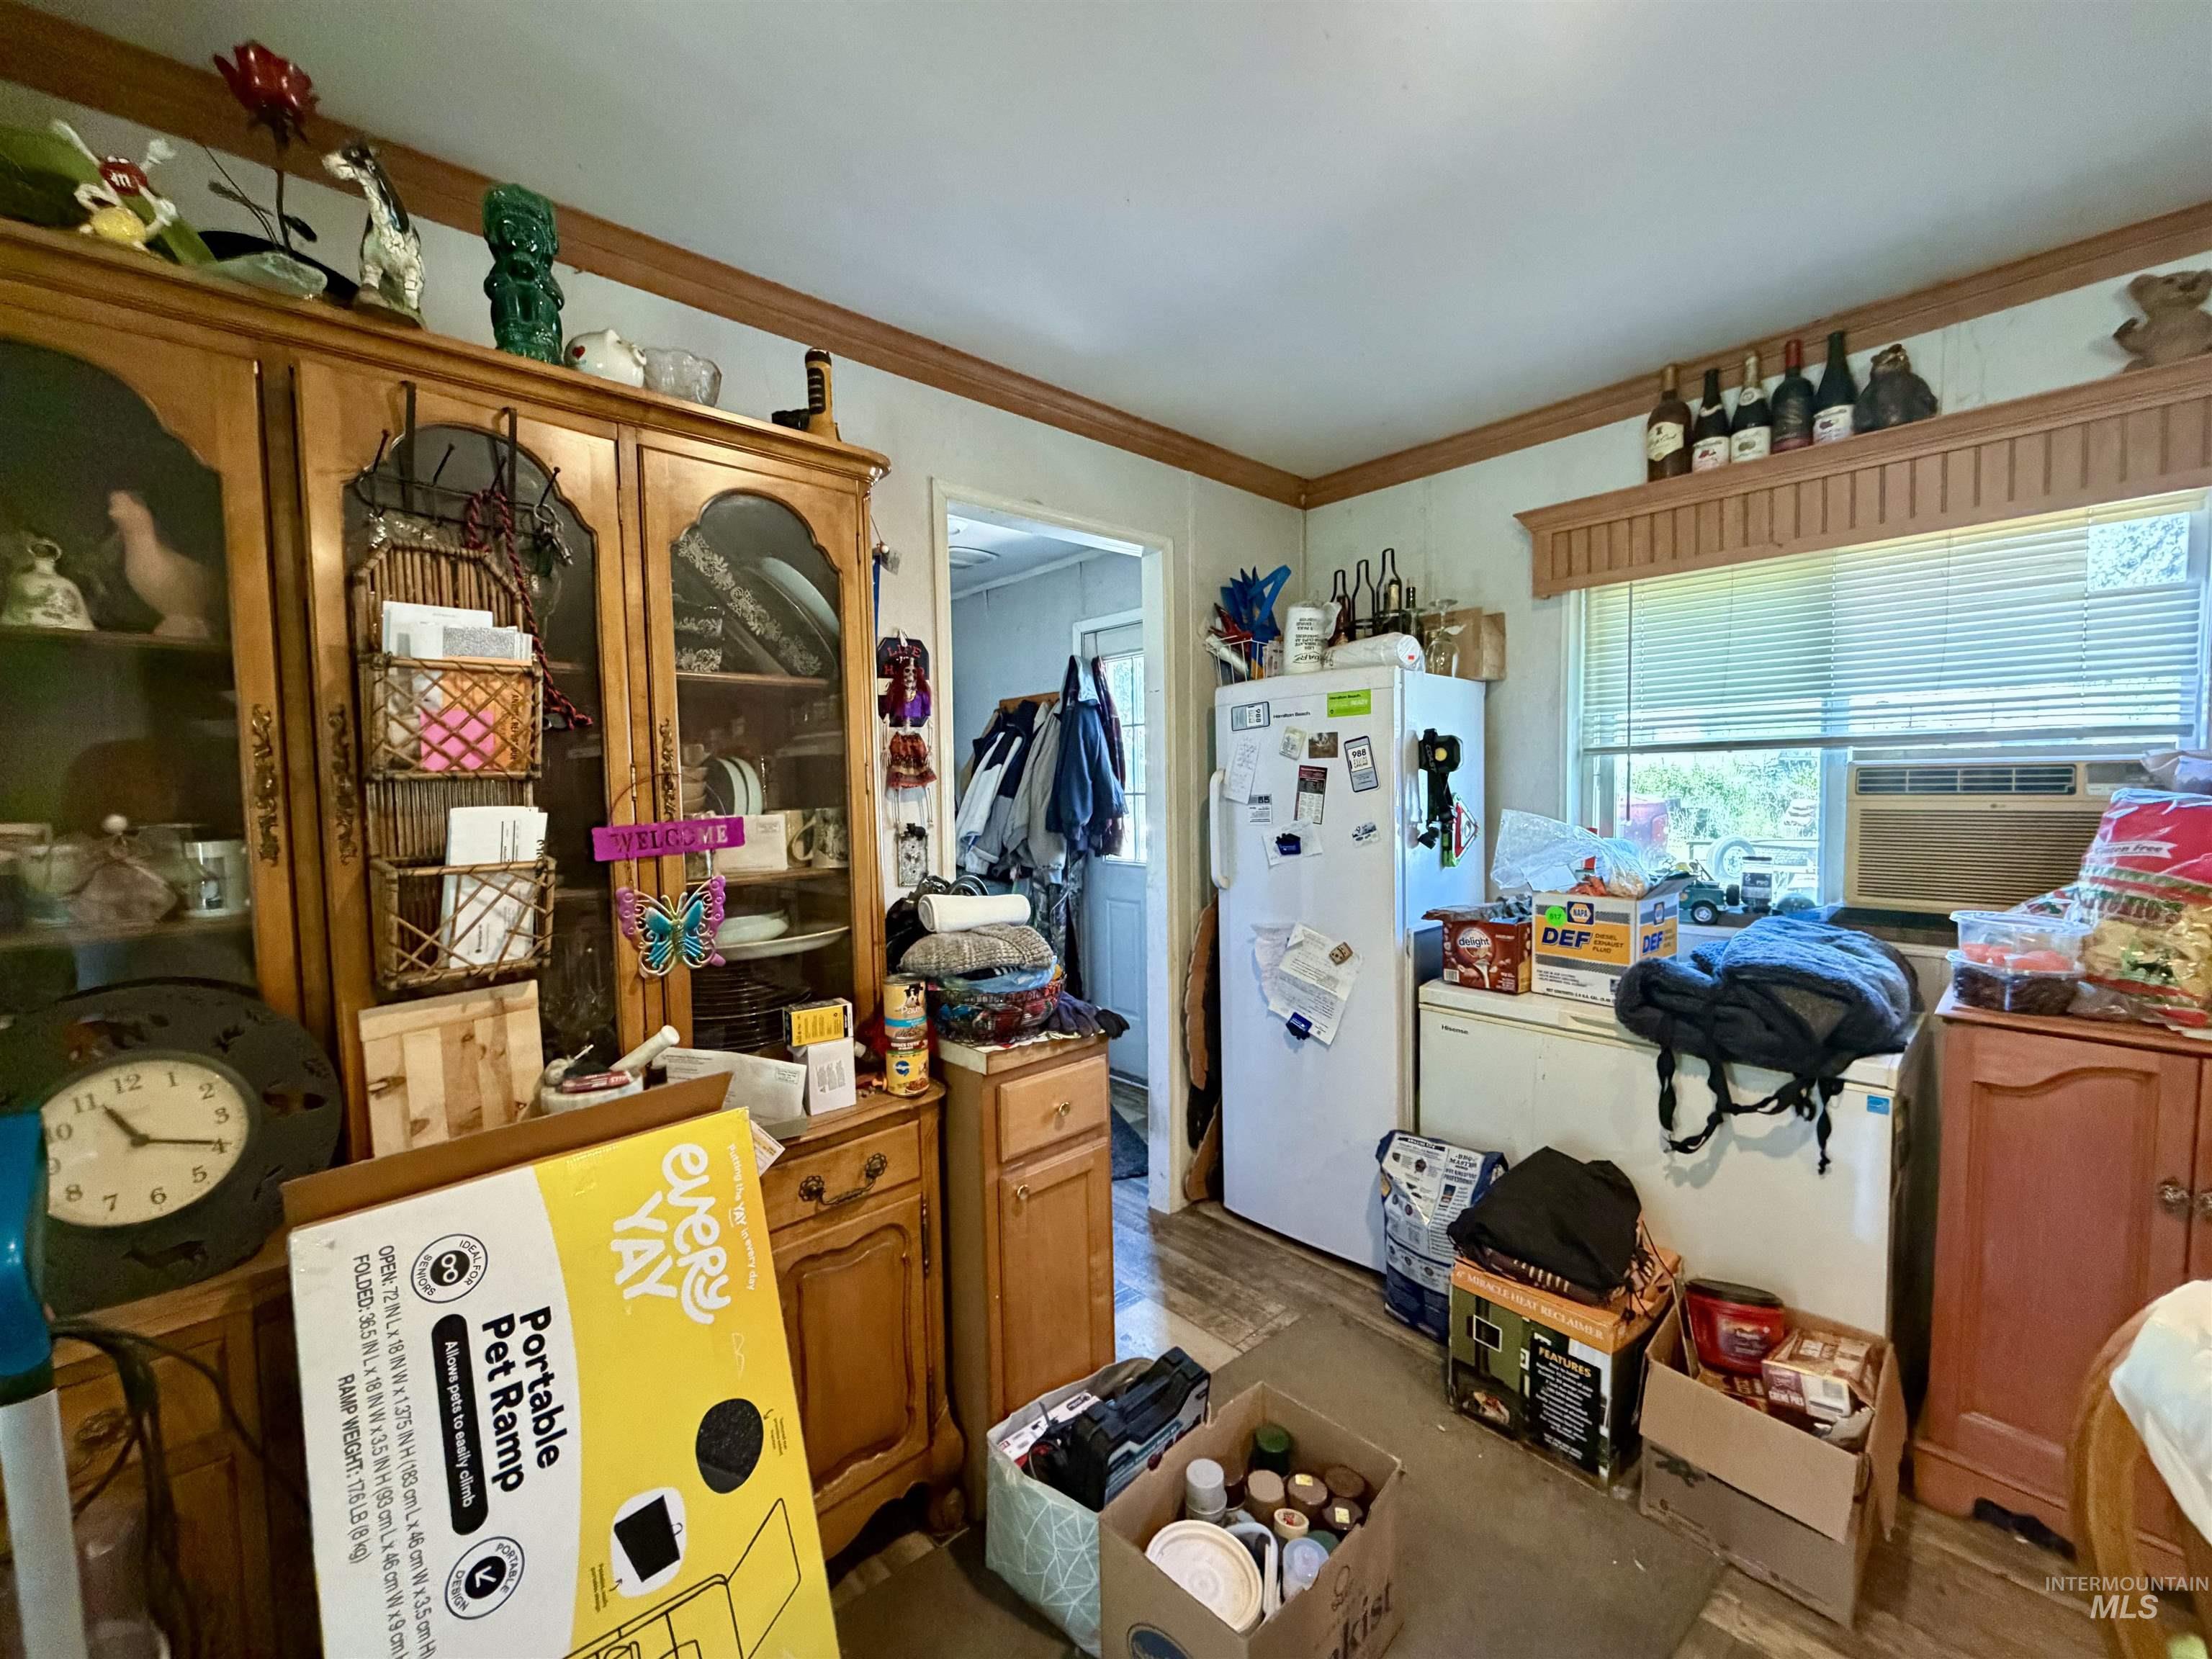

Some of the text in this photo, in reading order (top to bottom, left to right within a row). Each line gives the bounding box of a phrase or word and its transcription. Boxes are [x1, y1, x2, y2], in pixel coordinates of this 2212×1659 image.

[1352, 749, 1367, 759] 988
[609, 824, 728, 853] WELCOME
[1573, 909, 1588, 918] NAPA
[1459, 937, 1490, 948] delight
[1542, 927, 1593, 949] DEF
[1642, 931, 1664, 955] DEF
[1442, 1024, 1469, 1035] Hisense
[114, 1074, 143, 1094] 12
[166, 1071, 179, 1087] 1
[199, 1083, 215, 1100] 2
[72, 1093, 96, 1114] 11
[215, 1106, 230, 1124] 3
[192, 1165, 207, 1183] 5
[66, 1184, 83, 1202] 8
[150, 1187, 167, 1205] 6
[735, 1183, 744, 1202] the
[103, 1193, 118, 1212] 7
[734, 1202, 747, 1226] YAY
[741, 1227, 749, 1240] in
[611, 1190, 678, 1300] YAY
[745, 1239, 756, 1268] every
[378, 1245, 397, 1287] OPEN:
[459, 1240, 482, 1285] IDEAL FOR
[353, 1254, 374, 1313] FOLDED:
[415, 1254, 436, 1297] SENIORS
[747, 1272, 757, 1290] day
[382, 1286, 399, 1303] 72
[384, 1303, 402, 1318] IN
[1467, 1274, 1511, 1300] MIRACLE
[1511, 1295, 1538, 1312] HEAT
[1541, 1305, 1604, 1340] RECLAIMER
[359, 1313, 377, 1340] 36.5
[386, 1318, 402, 1329] L
[387, 1329, 399, 1339] x
[361, 1339, 379, 1356] IN
[388, 1339, 405, 1354] 18
[363, 1354, 380, 1367] L
[390, 1354, 407, 1371] IN
[1539, 1346, 1591, 1378] FEATURES
[364, 1367, 377, 1377] x
[391, 1368, 408, 1385] W
[365, 1377, 382, 1393] 18
[392, 1386, 405, 1396] x
[519, 1305, 567, 1469] Portable
[367, 1392, 385, 1409] IN
[482, 1313, 524, 1493] Pet Ramp
[368, 1407, 387, 1424] W
[445, 1341, 477, 1508] Allows pets to easily climb
[370, 1424, 382, 1436] x
[397, 1429, 415, 1447] IN
[371, 1434, 389, 1457] 3.5
[398, 1444, 416, 1460] H
[338, 1373, 372, 1564] RAMP WEIGHT: 17.6 LB (8 kg)
[373, 1455, 391, 1473] IN
[374, 1471, 392, 1486] H
[397, 1460, 418, 1488] (183
[372, 1486, 394, 1509] (93
[403, 1488, 418, 1510] cm
[378, 1509, 392, 1532] cm
[405, 1508, 423, 1521] L
[406, 1519, 420, 1532] x
[380, 1528, 397, 1542] L
[408, 1532, 425, 1549] 46
[382, 1540, 395, 1553] x
[382, 1553, 400, 1571] 46
[409, 1549, 424, 1571] cm
[495, 1542, 518, 1593] PORTABLE
[384, 1571, 398, 1593] cm
[412, 1568, 429, 1586] W
[386, 1590, 404, 1609] W
[413, 1586, 426, 1599] x
[451, 1570, 469, 1611] DESIGN
[388, 1609, 401, 1622] x
[414, 1596, 432, 1621] 3.5
[388, 1619, 406, 1632] 9
[415, 1620, 431, 1644] cm
[390, 1632, 405, 1655] cm
